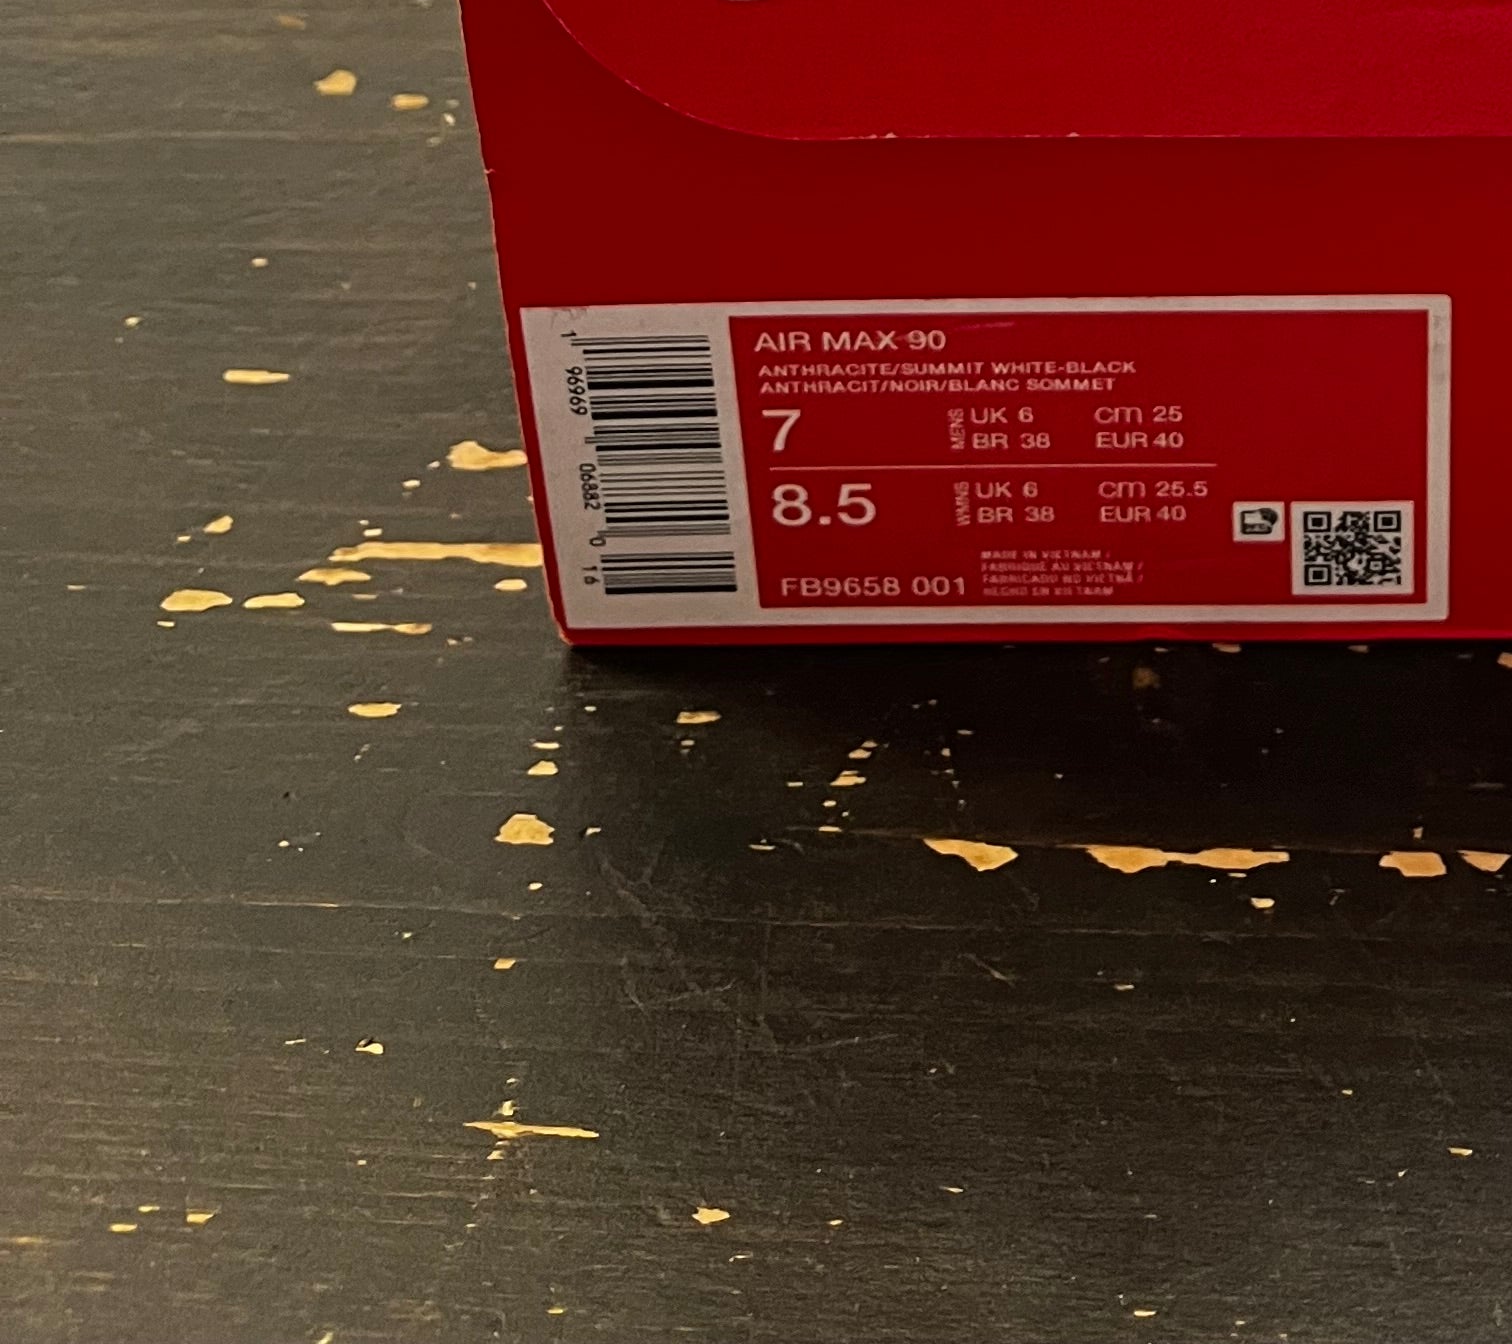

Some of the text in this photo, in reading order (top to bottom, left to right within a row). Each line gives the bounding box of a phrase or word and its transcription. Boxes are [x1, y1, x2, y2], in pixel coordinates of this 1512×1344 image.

[754, 329, 946, 353] AIR MAX 90
[758, 361, 1136, 378] ANTHRACITE/SUMMIT WHITE-BLACK
[565, 366, 589, 416] 96969
[760, 377, 1116, 395] ANTHRACIT/NOIR/BLANC SOMMET
[970, 406, 1034, 424] UK 6
[1153, 405, 1183, 423] 25
[762, 408, 802, 453] 7
[947, 408, 966, 450] MENS
[971, 432, 1051, 449] BR 38
[1095, 431, 1184, 449] EUR 40
[578, 463, 601, 511] 06882
[975, 480, 1039, 499] UK 6
[1154, 480, 1209, 497] 25.5
[771, 482, 877, 527] 8.5
[976, 506, 1055, 524] BR 38
[1099, 505, 1188, 523] EUR 40
[780, 575, 965, 597] FB9658 001
